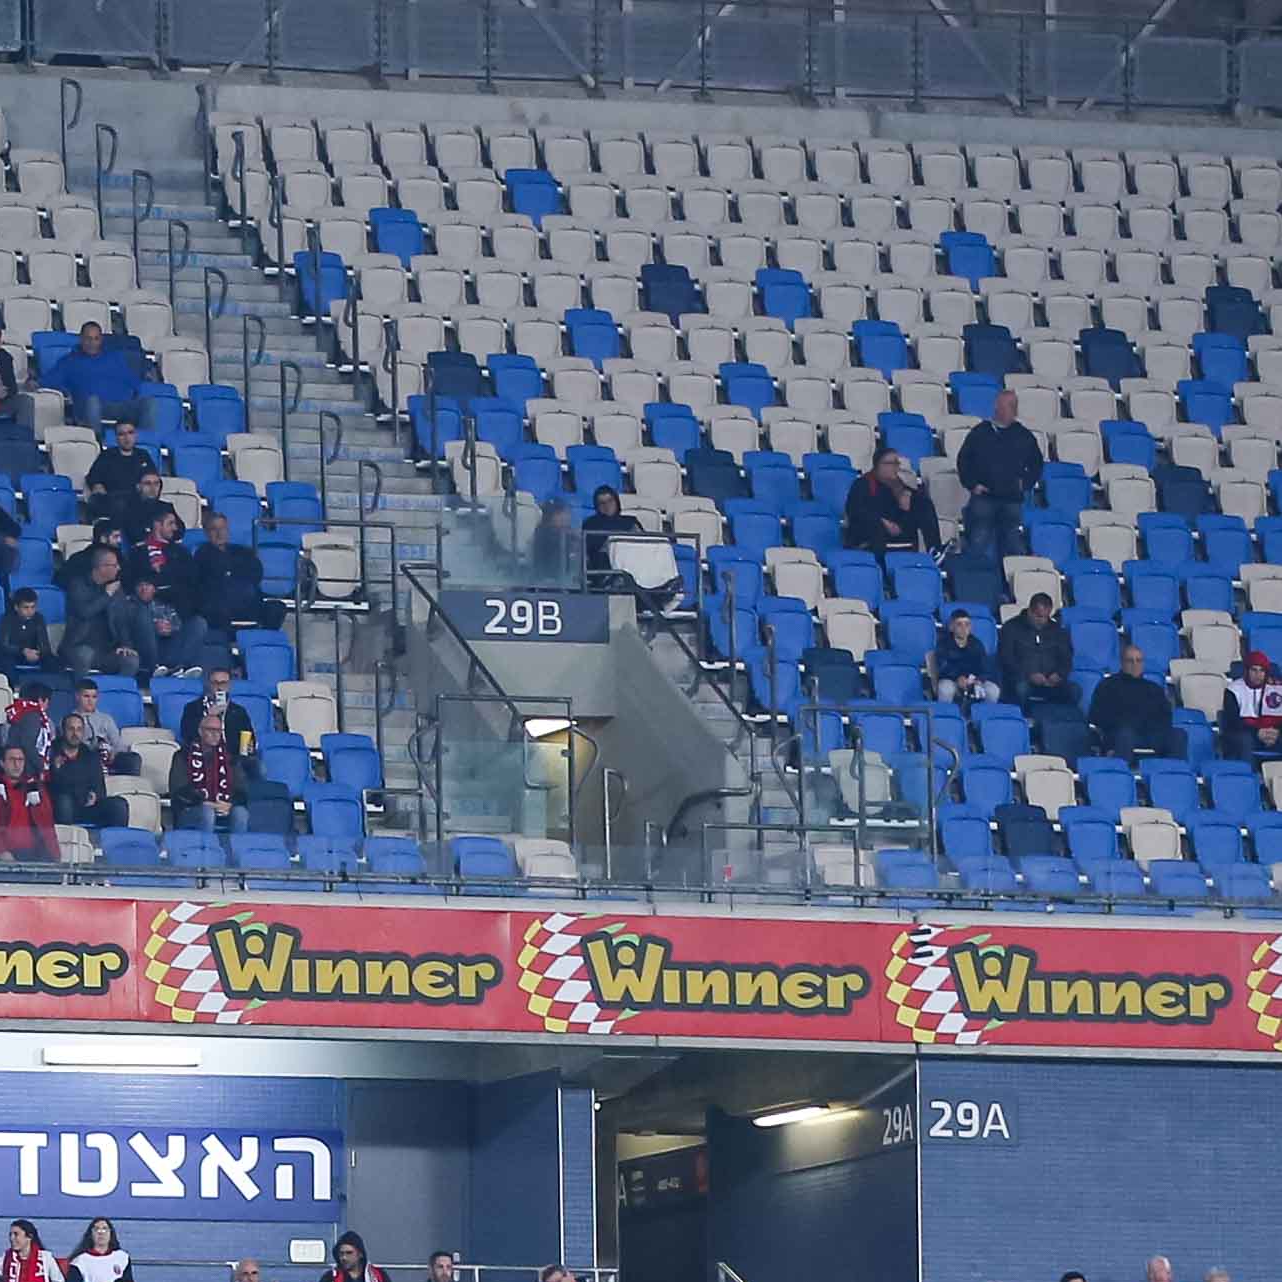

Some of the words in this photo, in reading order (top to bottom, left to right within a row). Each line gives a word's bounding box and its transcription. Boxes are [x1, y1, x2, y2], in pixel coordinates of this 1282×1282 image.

[484, 599, 562, 635] 29B
[218, 930, 496, 997] Winner
[590, 942, 864, 1008] Winner
[956, 953, 1225, 1016] Winner
[882, 1104, 914, 1145] 29A
[929, 1101, 1010, 1139] 29A
